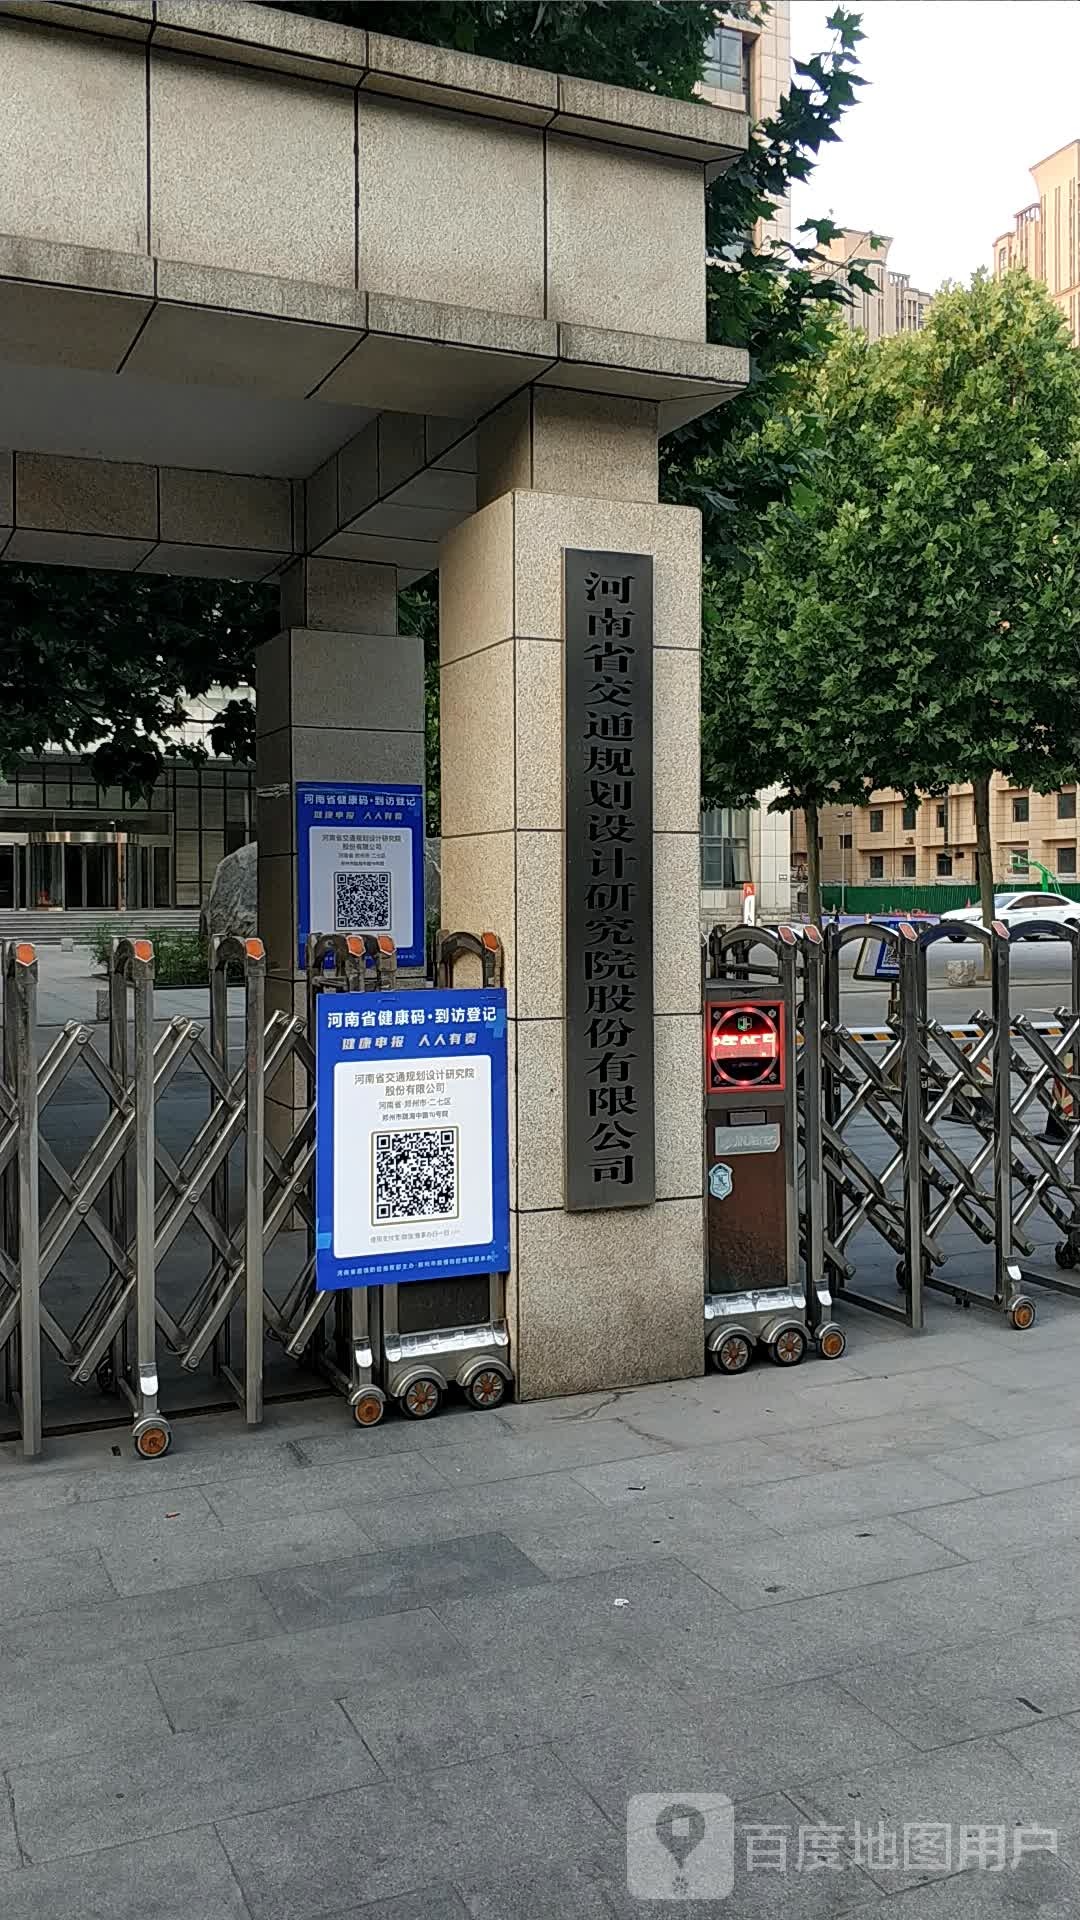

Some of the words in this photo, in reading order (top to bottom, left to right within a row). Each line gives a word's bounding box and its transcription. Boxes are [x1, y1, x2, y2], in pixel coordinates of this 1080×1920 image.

[583, 571, 639, 1185] 河南省交通规划设计研究院股份有限公司
[327, 1006, 497, 1028] 河南省健康码·到访登记
[354, 1067, 475, 1085] 河南省交通规划设计研究院
[384, 1083, 445, 1097] 股份有限公司
